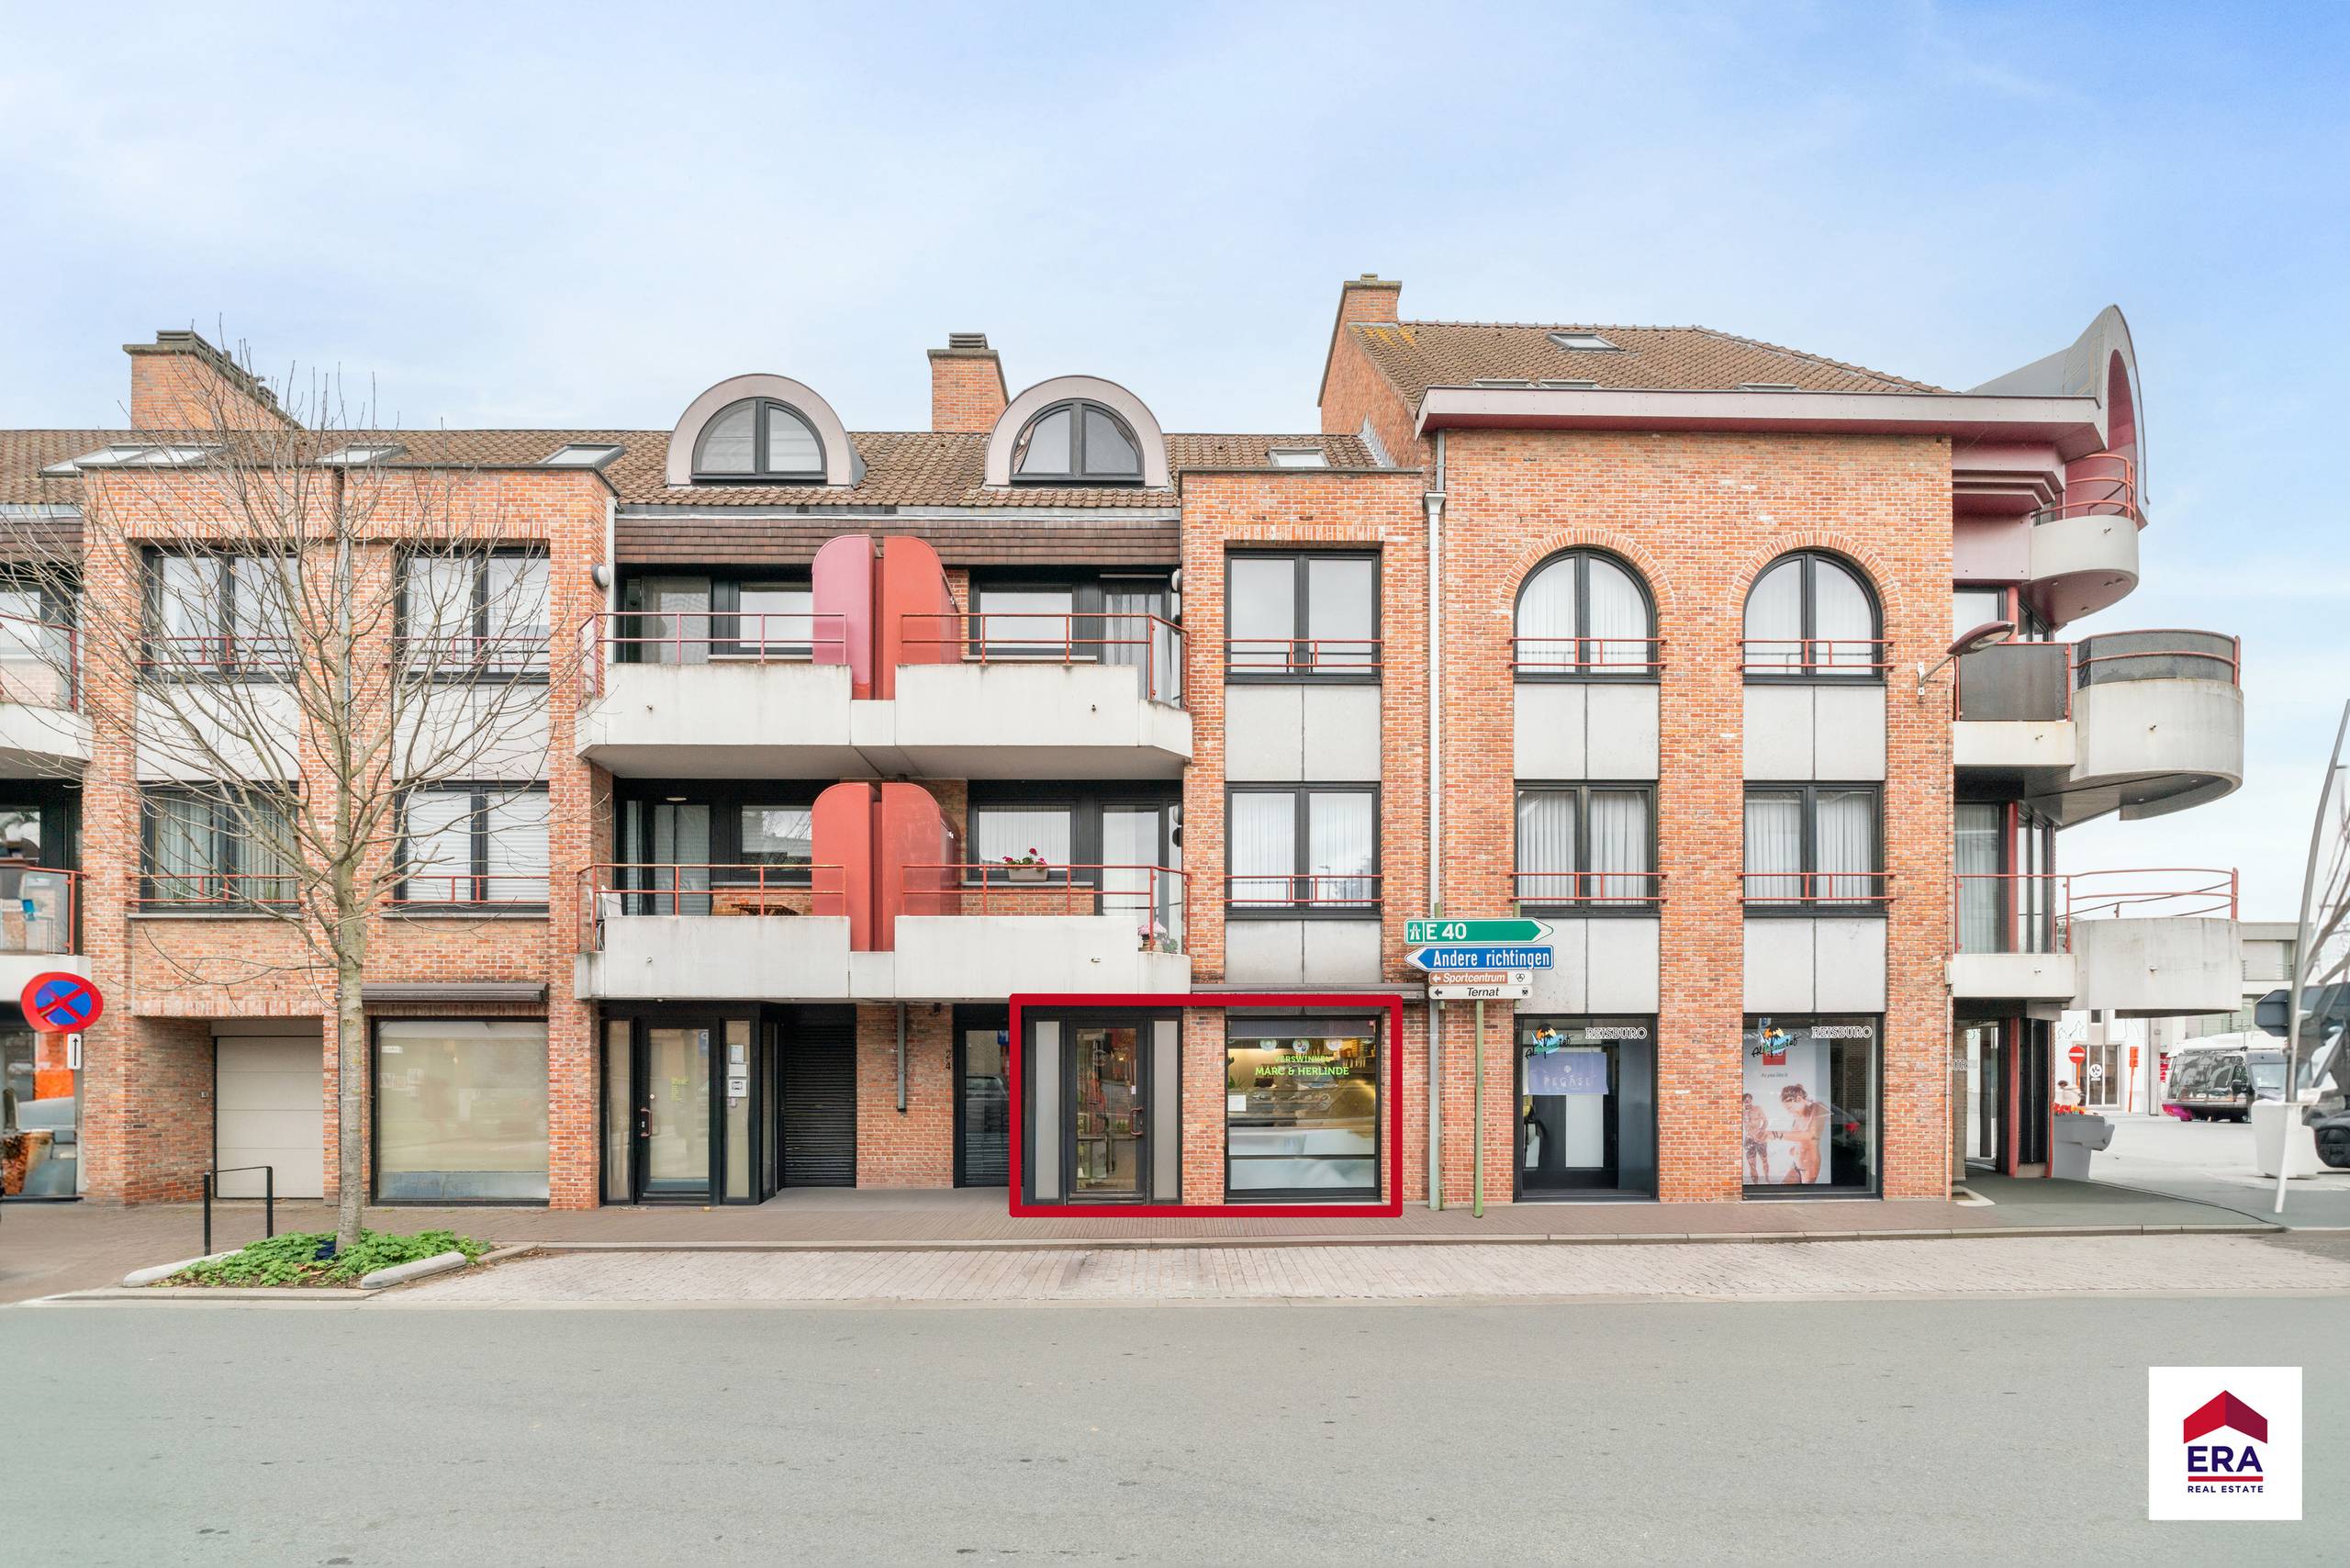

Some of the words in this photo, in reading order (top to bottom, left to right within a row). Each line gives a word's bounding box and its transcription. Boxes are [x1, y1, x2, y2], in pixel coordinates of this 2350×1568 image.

[1427, 924, 1438, 940] E
[1441, 924, 1467, 940] 40
[1433, 950, 1478, 967] Andere
[1486, 949, 1550, 969] richtingen
[1443, 973, 1505, 984] Sportcentrum
[1467, 987, 1500, 997] Ternat
[1585, 1026, 1648, 1039] REISBURO
[1811, 1025, 1873, 1038] REISBURO
[1255, 1066, 1285, 1076] MARC
[1288, 1066, 1295, 1075] &
[1297, 1066, 1349, 1076] HERLINDE
